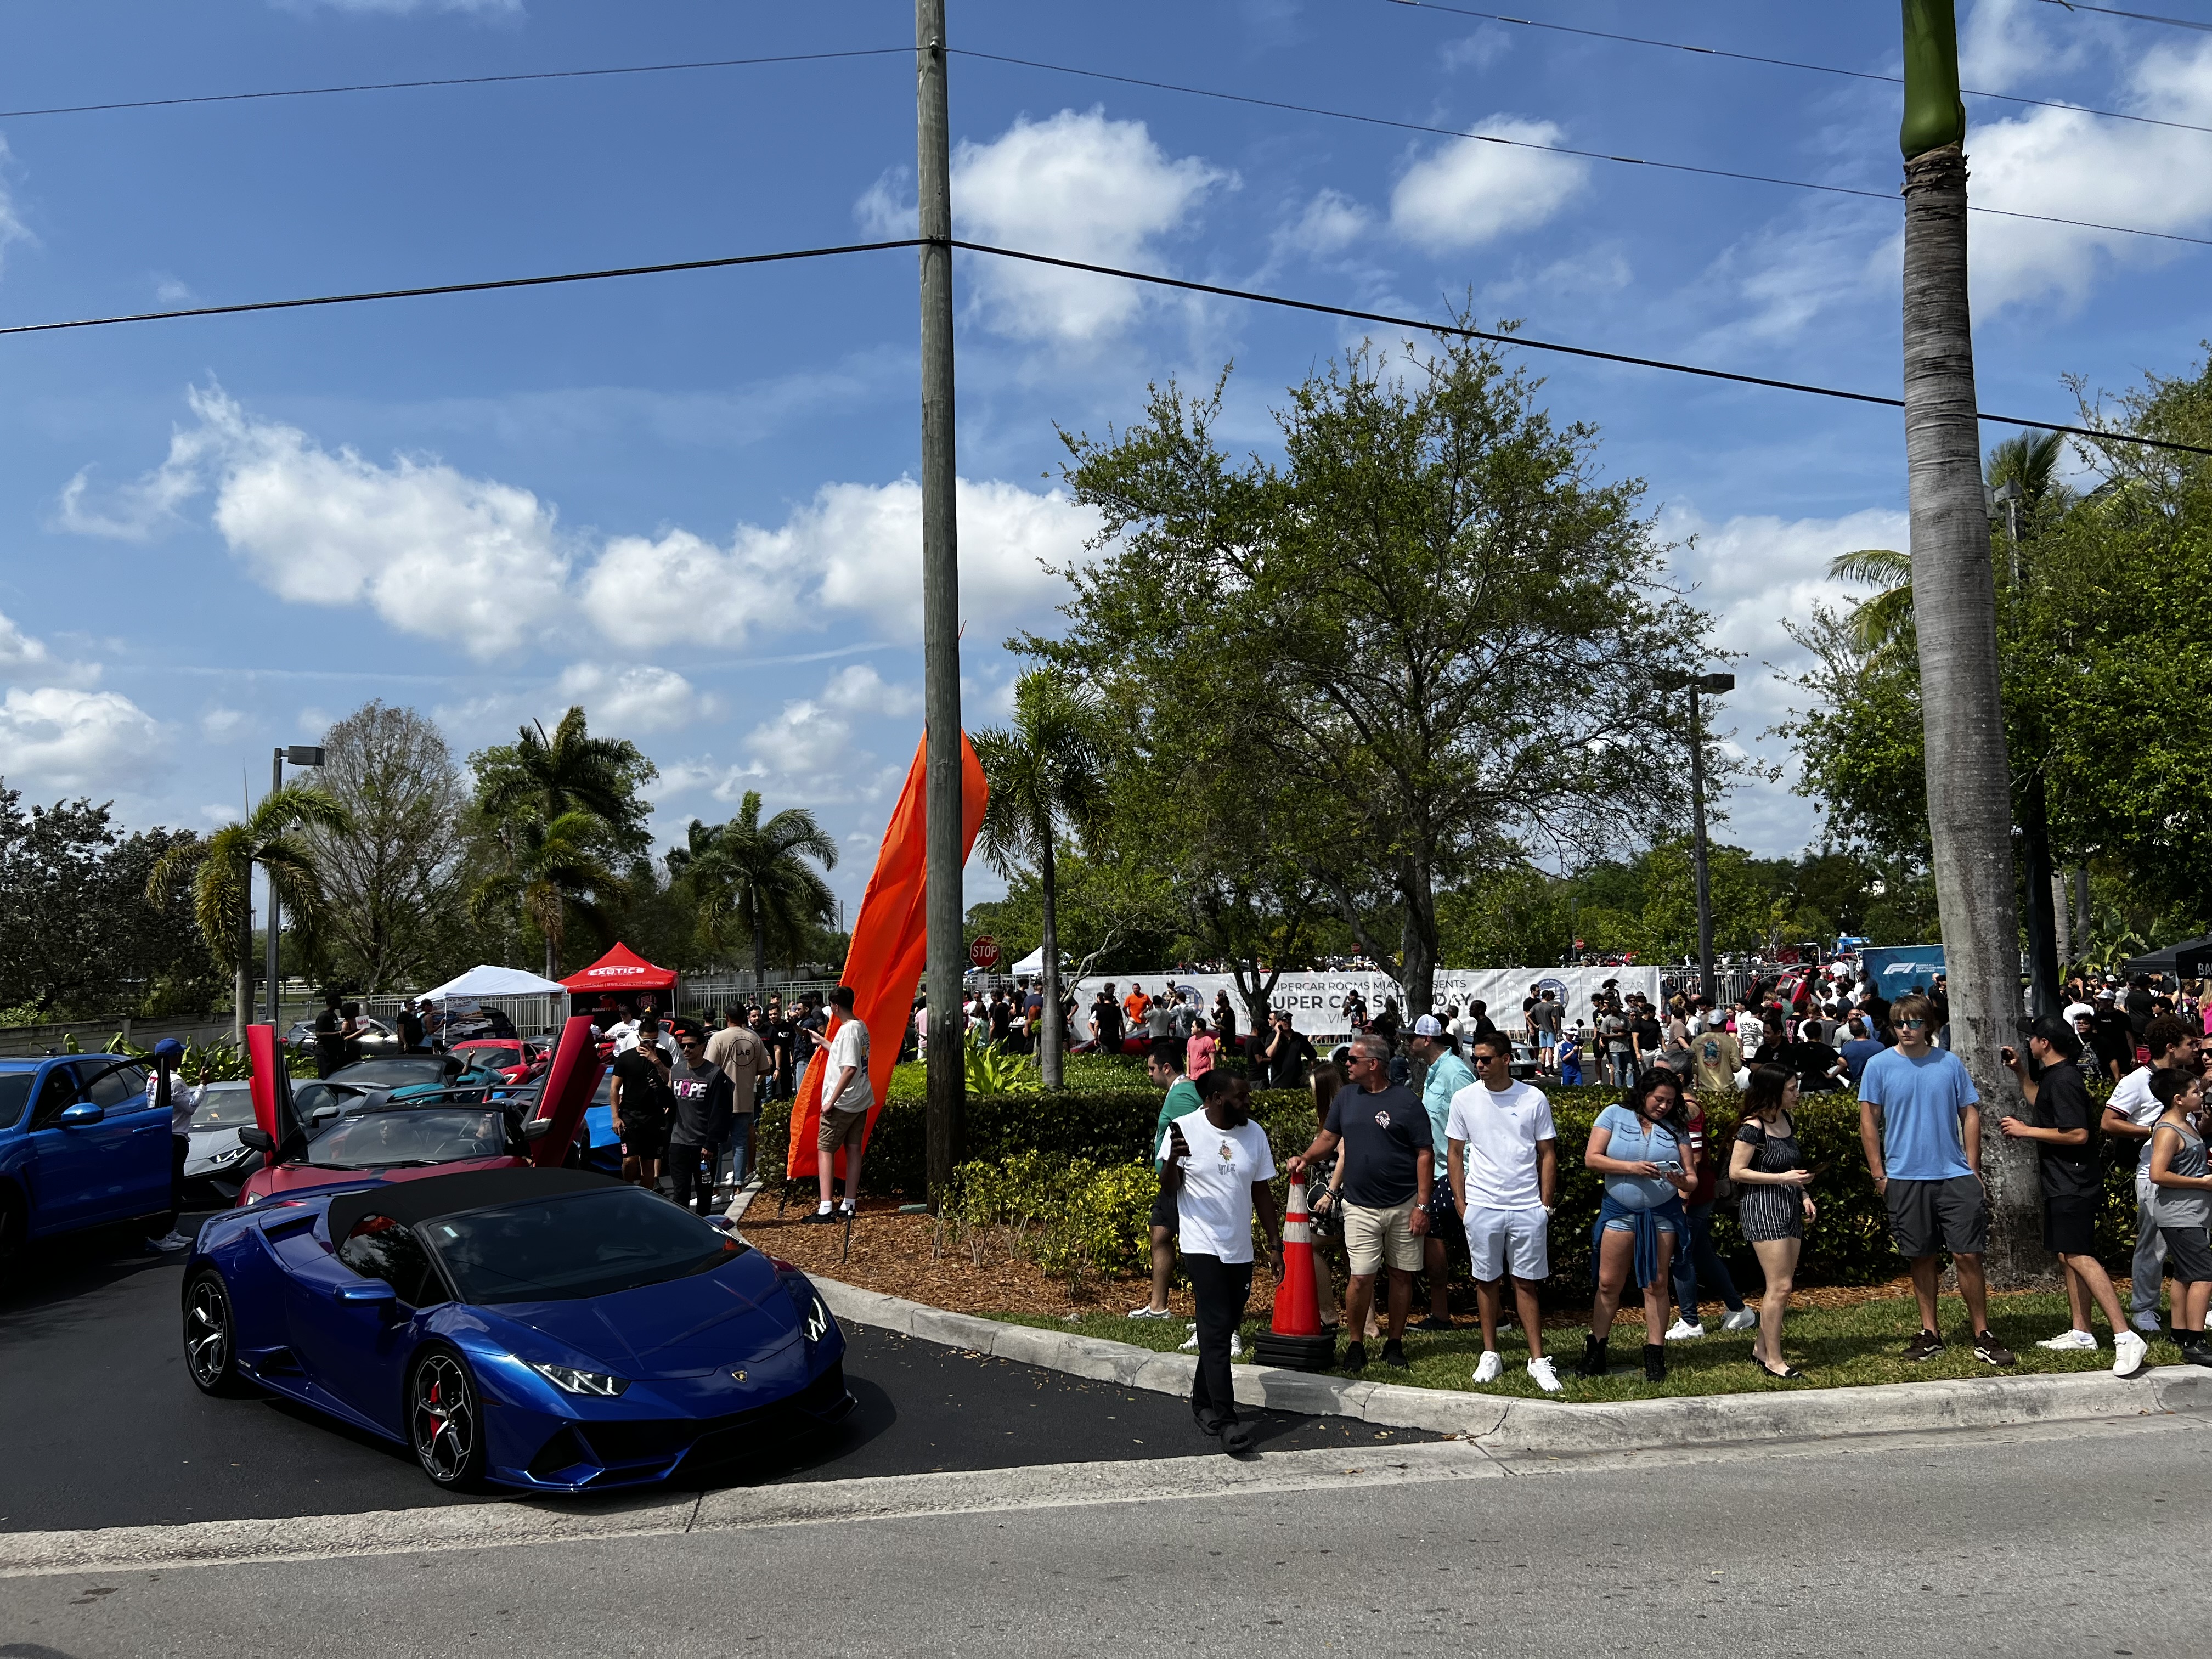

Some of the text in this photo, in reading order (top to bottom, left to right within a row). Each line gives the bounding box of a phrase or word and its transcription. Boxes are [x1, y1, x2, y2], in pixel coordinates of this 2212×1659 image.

[973, 945, 997, 957] STOP
[589, 967, 645, 976] EXOTICS
[2197, 963, 2212, 975] BA
[1273, 982, 1325, 991] UPERCAR
[1328, 981, 1370, 990] ROOMS
[1266, 995, 1323, 1009] UPER
[674, 1080, 708, 1098] HOPE
